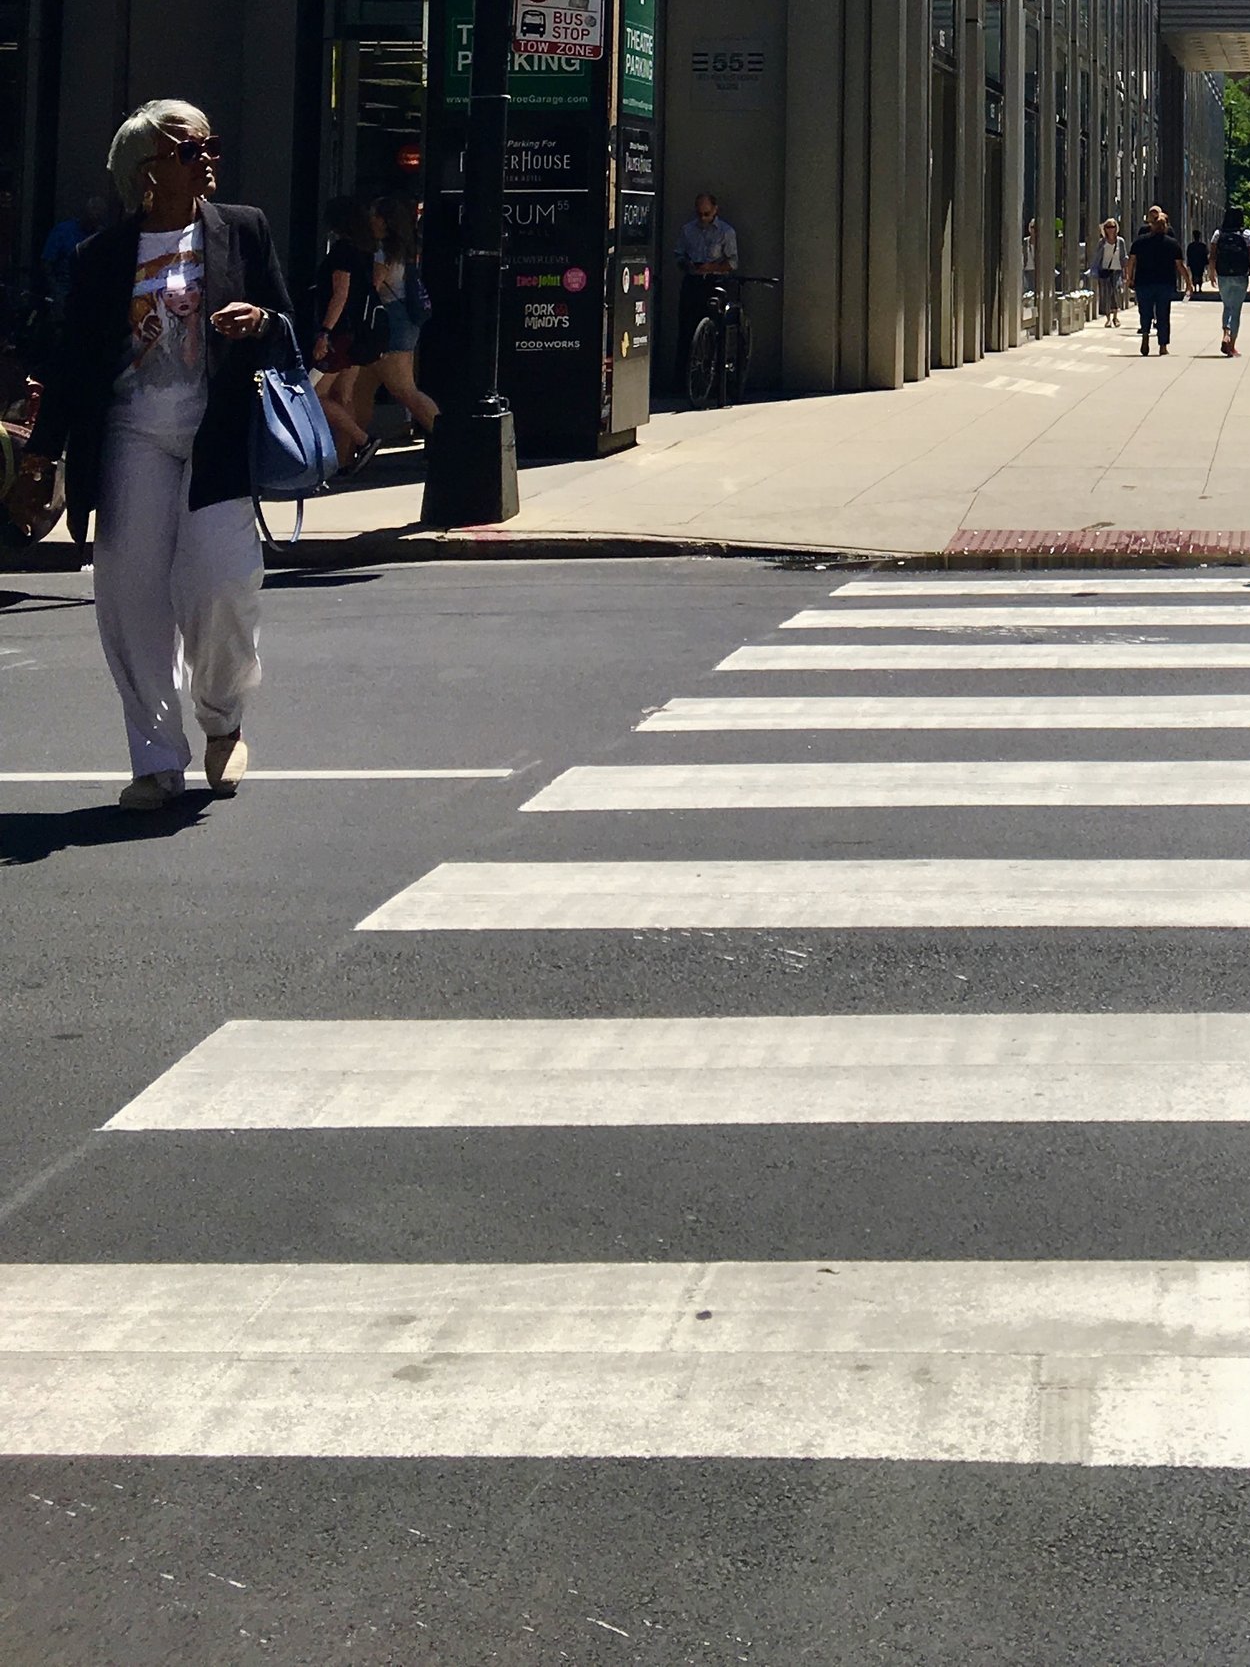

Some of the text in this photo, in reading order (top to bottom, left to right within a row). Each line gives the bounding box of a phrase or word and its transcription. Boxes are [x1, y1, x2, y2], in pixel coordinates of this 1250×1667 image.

[553, 11, 583, 26] BUS
[552, 26, 591, 40] STOP
[519, 40, 594, 57] TOW ZONE
[625, 27, 653, 56] THEATRE
[625, 53, 653, 81] PARKING
[712, 53, 744, 72] 55
[507, 138, 557, 150] Parking For
[525, 303, 555, 316] PORK
